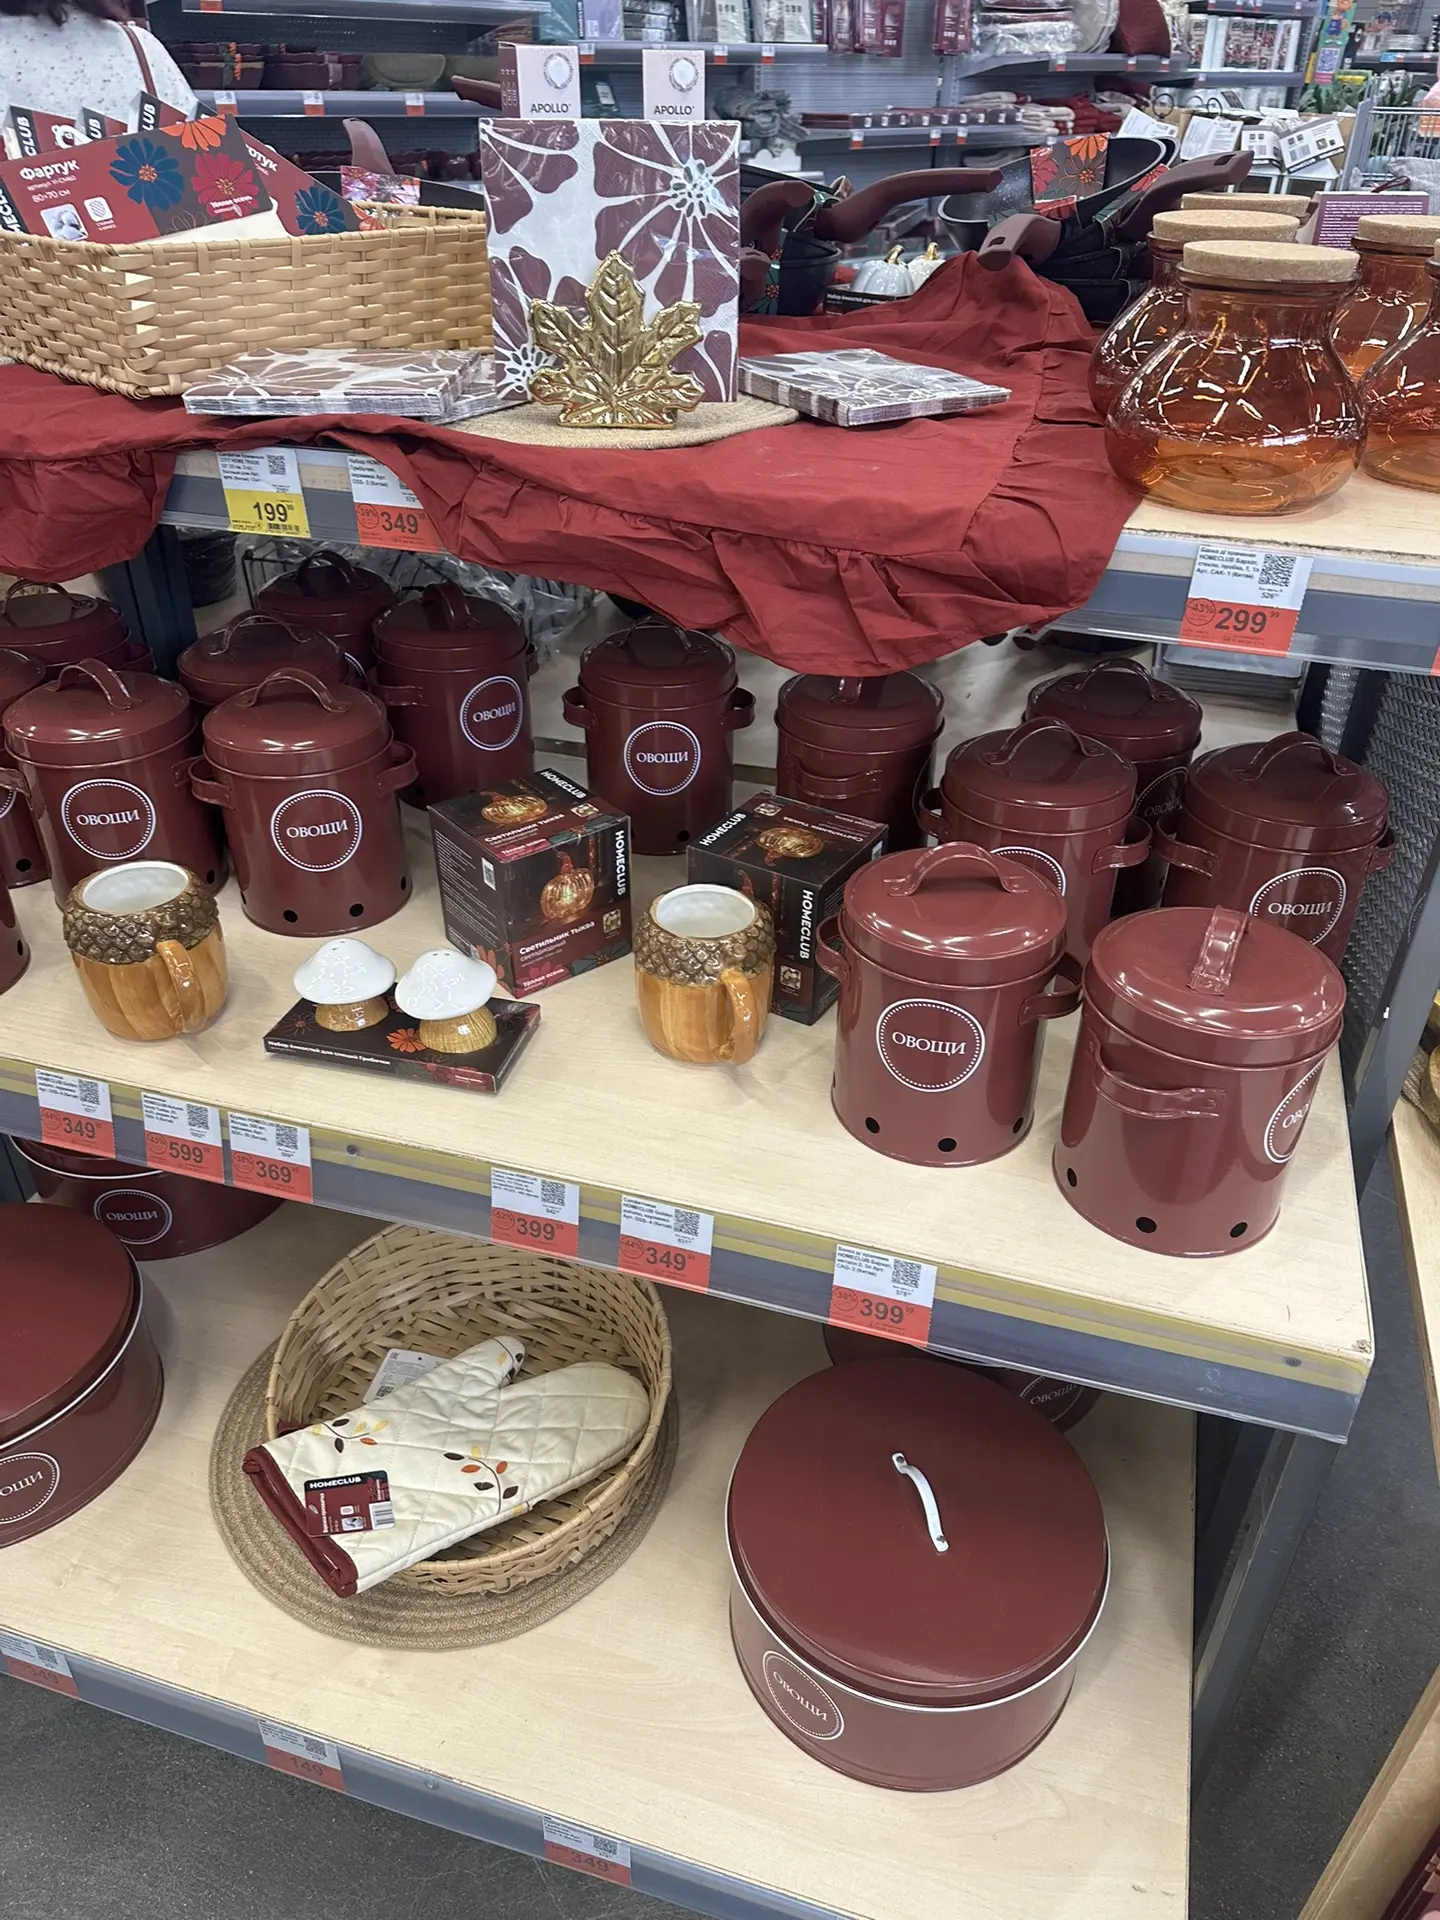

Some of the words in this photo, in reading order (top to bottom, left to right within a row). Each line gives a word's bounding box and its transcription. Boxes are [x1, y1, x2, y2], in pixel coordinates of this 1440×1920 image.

[531, 103, 569, 114] APOLLO
[654, 105, 692, 115] APOLLO
[18, 116, 36, 157] CLUB
[20, 159, 80, 181] Фартук
[253, 501, 288, 522] 199
[380, 511, 418, 534] 349
[1188, 603, 1214, 614] -43%
[1215, 608, 1267, 634] 299
[473, 701, 516, 723] ОВОЩИ
[636, 751, 689, 763] ОВОЩИ
[541, 770, 586, 799] HOMECLUB
[76, 809, 140, 826] ОВОЩИ
[286, 819, 348, 839] ОВОЩИ
[485, 824, 539, 842] Светильник
[537, 814, 565, 825] тыква
[700, 812, 746, 847] HOMECLUB
[614, 830, 626, 896] HOMECLUB
[1268, 901, 1332, 916] ОВОЩИ
[799, 889, 814, 960] HOMECLUB
[519, 931, 570, 955] Светильник
[570, 921, 596, 935] тыква
[892, 1031, 966, 1056] ОВОЩИ
[62, 1117, 95, 1139] 349
[169, 1141, 203, 1164] 599
[256, 1160, 291, 1183] 369
[106, 1210, 159, 1221] ОВОЩИ
[516, 1217, 555, 1240] 399
[646, 1247, 686, 1272] 349
[860, 1298, 903, 1324] 399
[0, 1471, 43, 1496] ОЩИ
[309, 1476, 362, 1489] HOMECLUB
[26, 1664, 58, 1684] 349
[773, 1671, 828, 1722] ОВОЩИ
[290, 1756, 323, 1777] 149
[572, 1852, 609, 1873] 349
